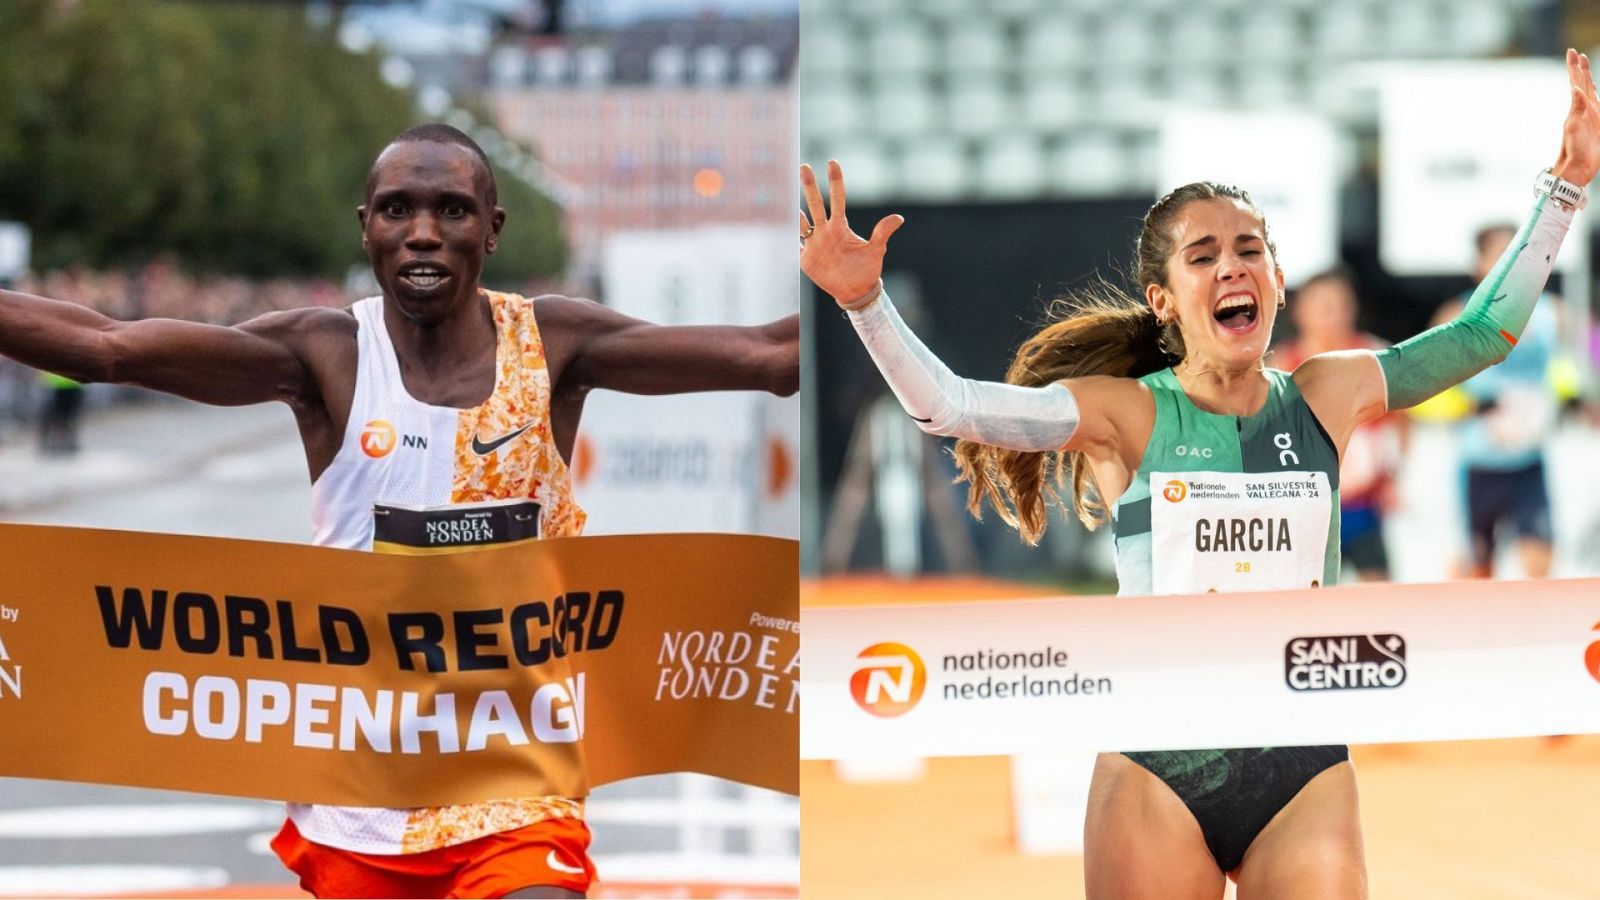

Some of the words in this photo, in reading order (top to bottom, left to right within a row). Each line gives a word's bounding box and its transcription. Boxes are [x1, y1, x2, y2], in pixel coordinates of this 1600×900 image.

[403, 434, 428, 450] NN
[1175, 445, 1213, 458] OAC
[1246, 482, 1265, 491] SAN
[1268, 481, 1318, 490] SILVESTRE
[1190, 491, 1240, 500] nederlanden
[1247, 490, 1301, 499] VALLECANA
[1308, 490, 1319, 498] 24
[426, 518, 490, 533] NORDEA
[430, 528, 493, 543] FONDEN
[1195, 518, 1292, 552] GARCIA
[1235, 562, 1251, 573] 28
[1, 604, 19, 622] by
[95, 585, 371, 666] WORLD
[388, 590, 625, 673] RECORD
[943, 647, 1069, 671] nationale
[1290, 637, 1358, 665] SANI
[1288, 660, 1405, 690] CENTRO
[944, 674, 1113, 700] nederlanden
